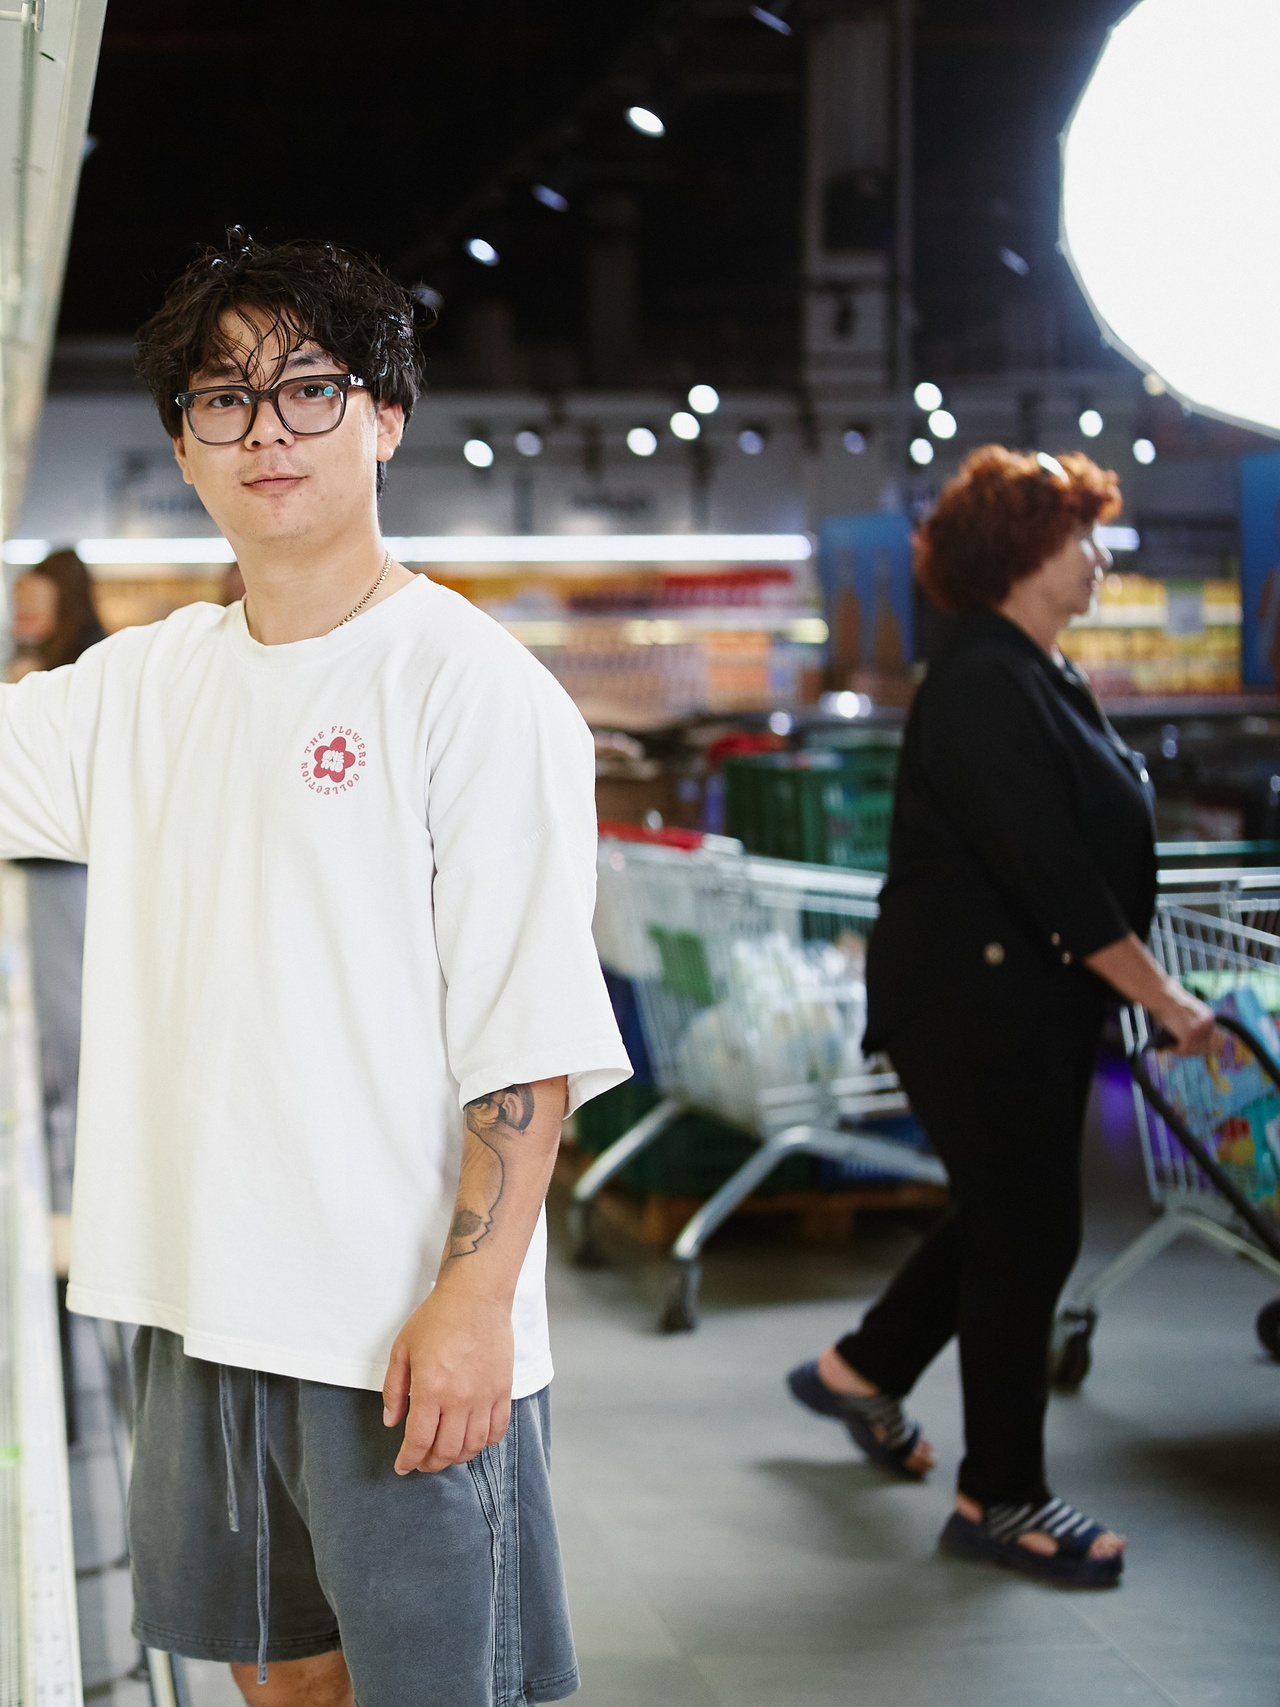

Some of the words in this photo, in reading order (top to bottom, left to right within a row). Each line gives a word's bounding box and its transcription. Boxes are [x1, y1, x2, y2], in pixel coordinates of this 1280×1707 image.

[304, 731, 325, 754] THE
[331, 725, 367, 767] FLOWERS
[300, 762, 360, 795] COLLECTION
